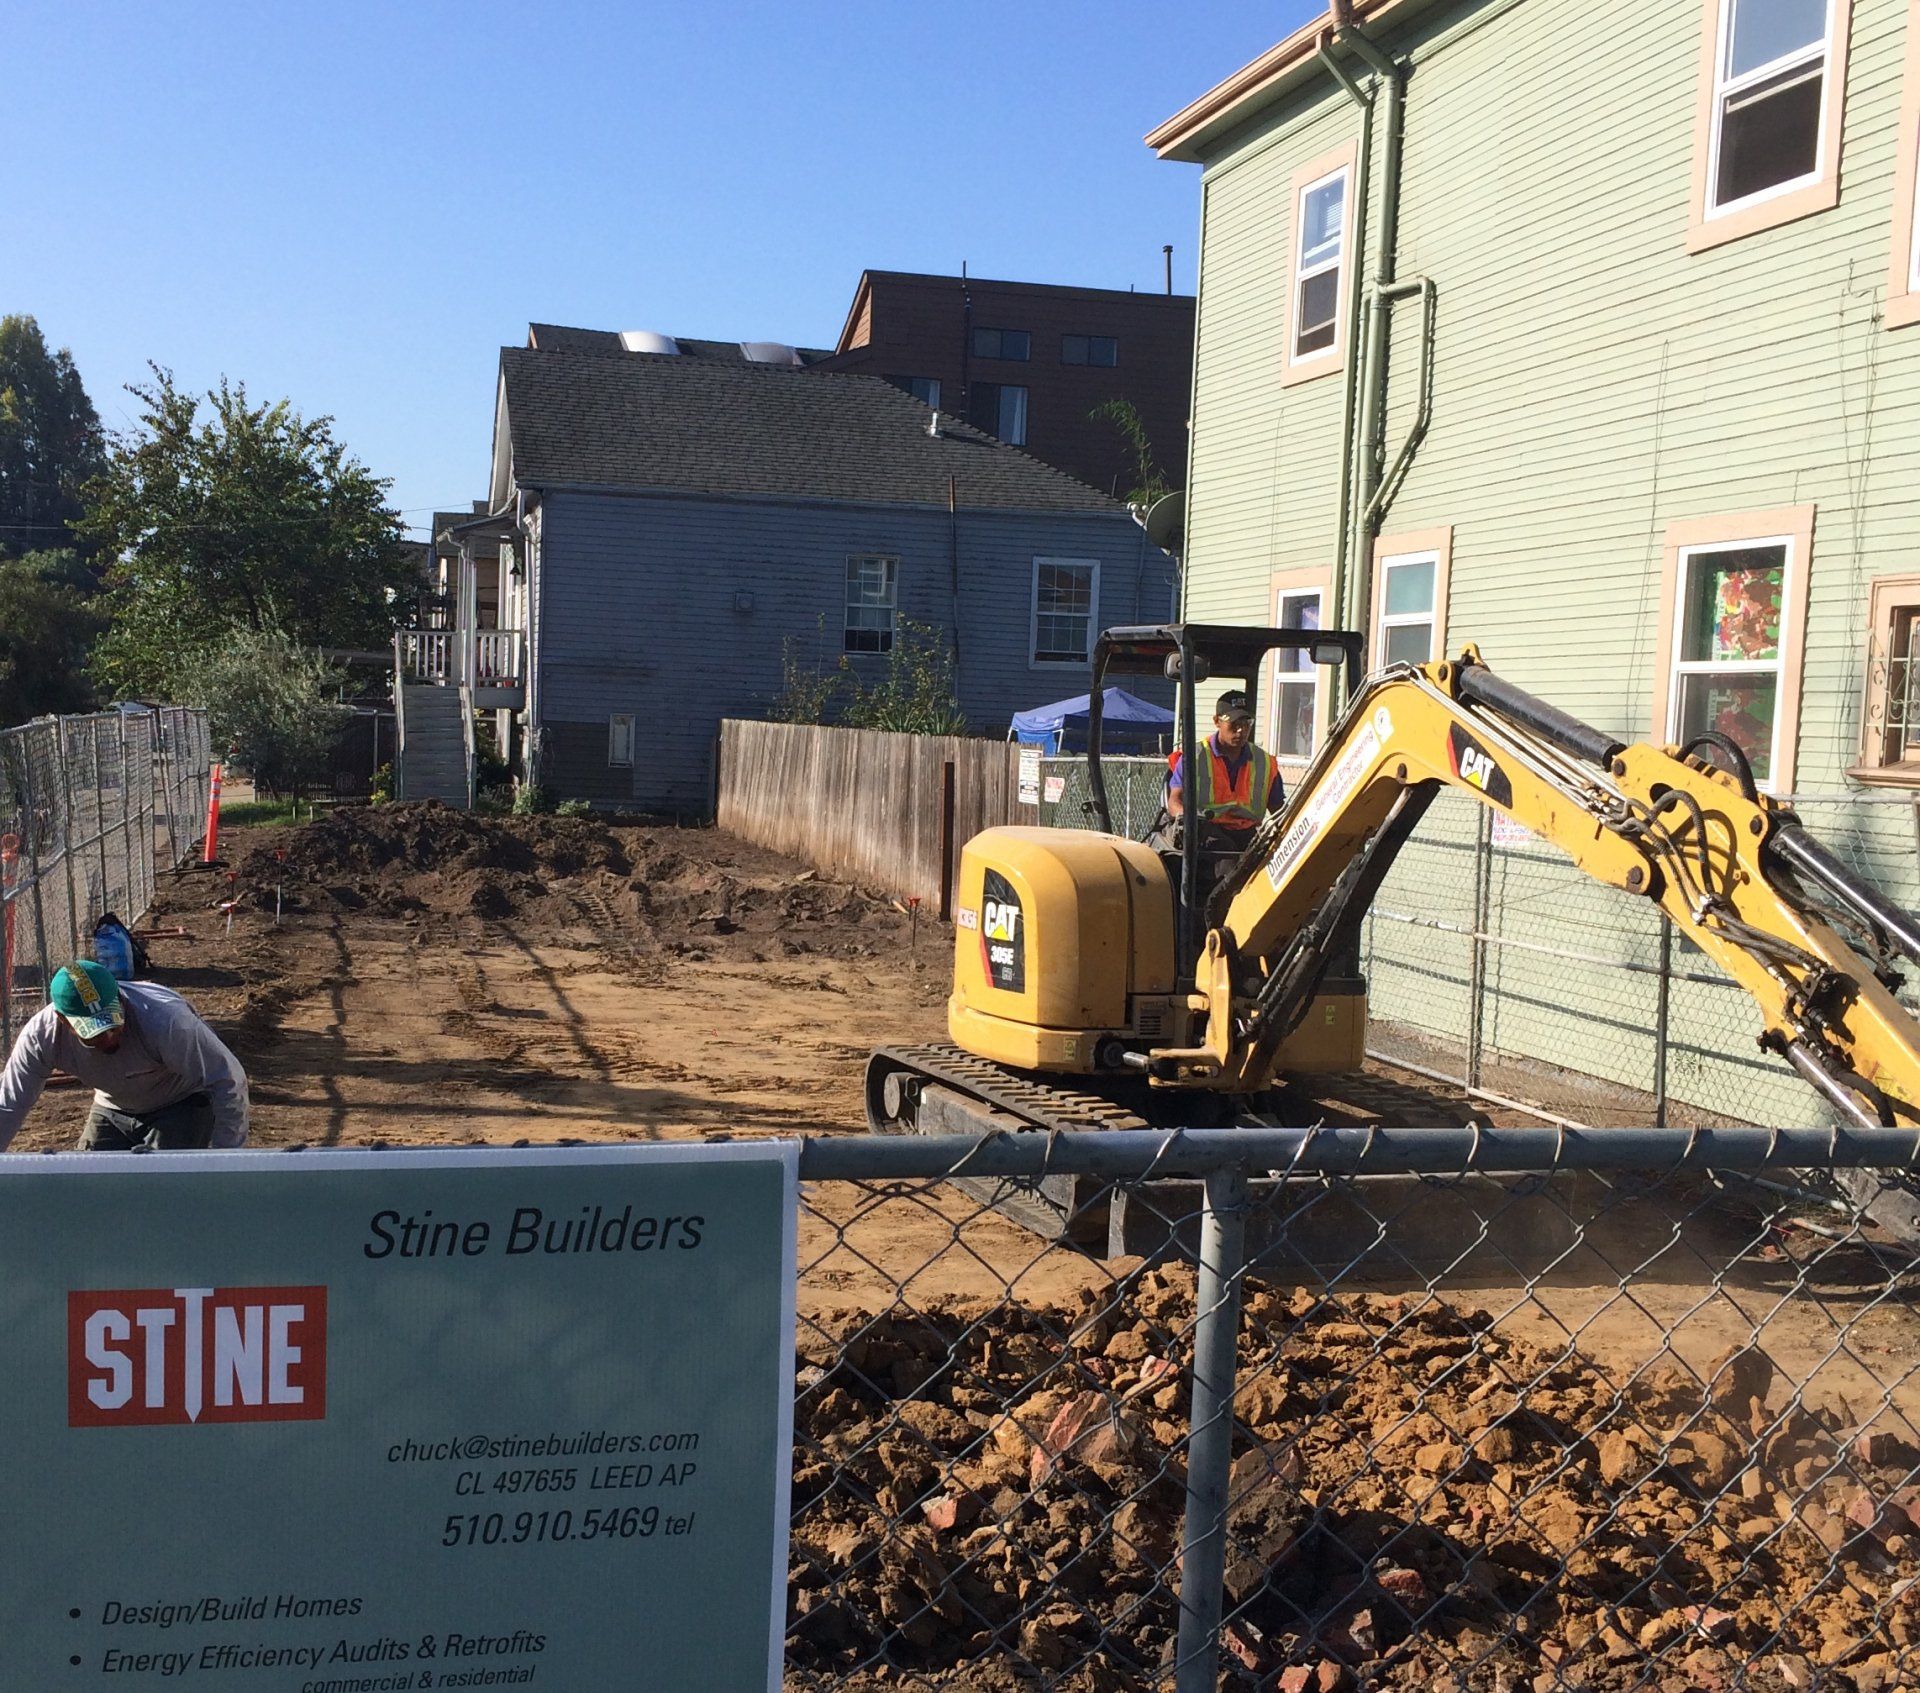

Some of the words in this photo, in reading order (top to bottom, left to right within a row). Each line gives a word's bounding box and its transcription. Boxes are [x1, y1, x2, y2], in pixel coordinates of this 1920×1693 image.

[1314, 773, 1340, 811] General
[1338, 730, 1376, 780] Engineering
[1332, 761, 1365, 804] Contractor
[1460, 746, 1495, 790] CAT
[1266, 816, 1311, 878] Dimension
[985, 901, 1020, 942] CAT
[990, 945, 1014, 966] 305E
[363, 1209, 491, 1260] Stine
[505, 1204, 706, 1256] Builders
[84, 1287, 305, 1423] STINE
[387, 1430, 700, 1464] chuck@stinebuilders.com
[455, 1471, 486, 1497] CL
[492, 1468, 578, 1494] 497655
[589, 1464, 653, 1490] LEED
[658, 1462, 697, 1487] AP
[442, 1506, 660, 1548] 510.910.5469
[664, 1511, 696, 1536] tel
[101, 1597, 267, 1629] Design/Build
[274, 1594, 363, 1620] Homes
[102, 1649, 194, 1677] Energy
[198, 1643, 326, 1671] Efficiency
[328, 1637, 410, 1664] Audits
[416, 1634, 437, 1659] &
[443, 1629, 548, 1658] Retrofits
[302, 1671, 414, 1693] commercial
[418, 1670, 433, 1689] &
[438, 1664, 536, 1688] residential
